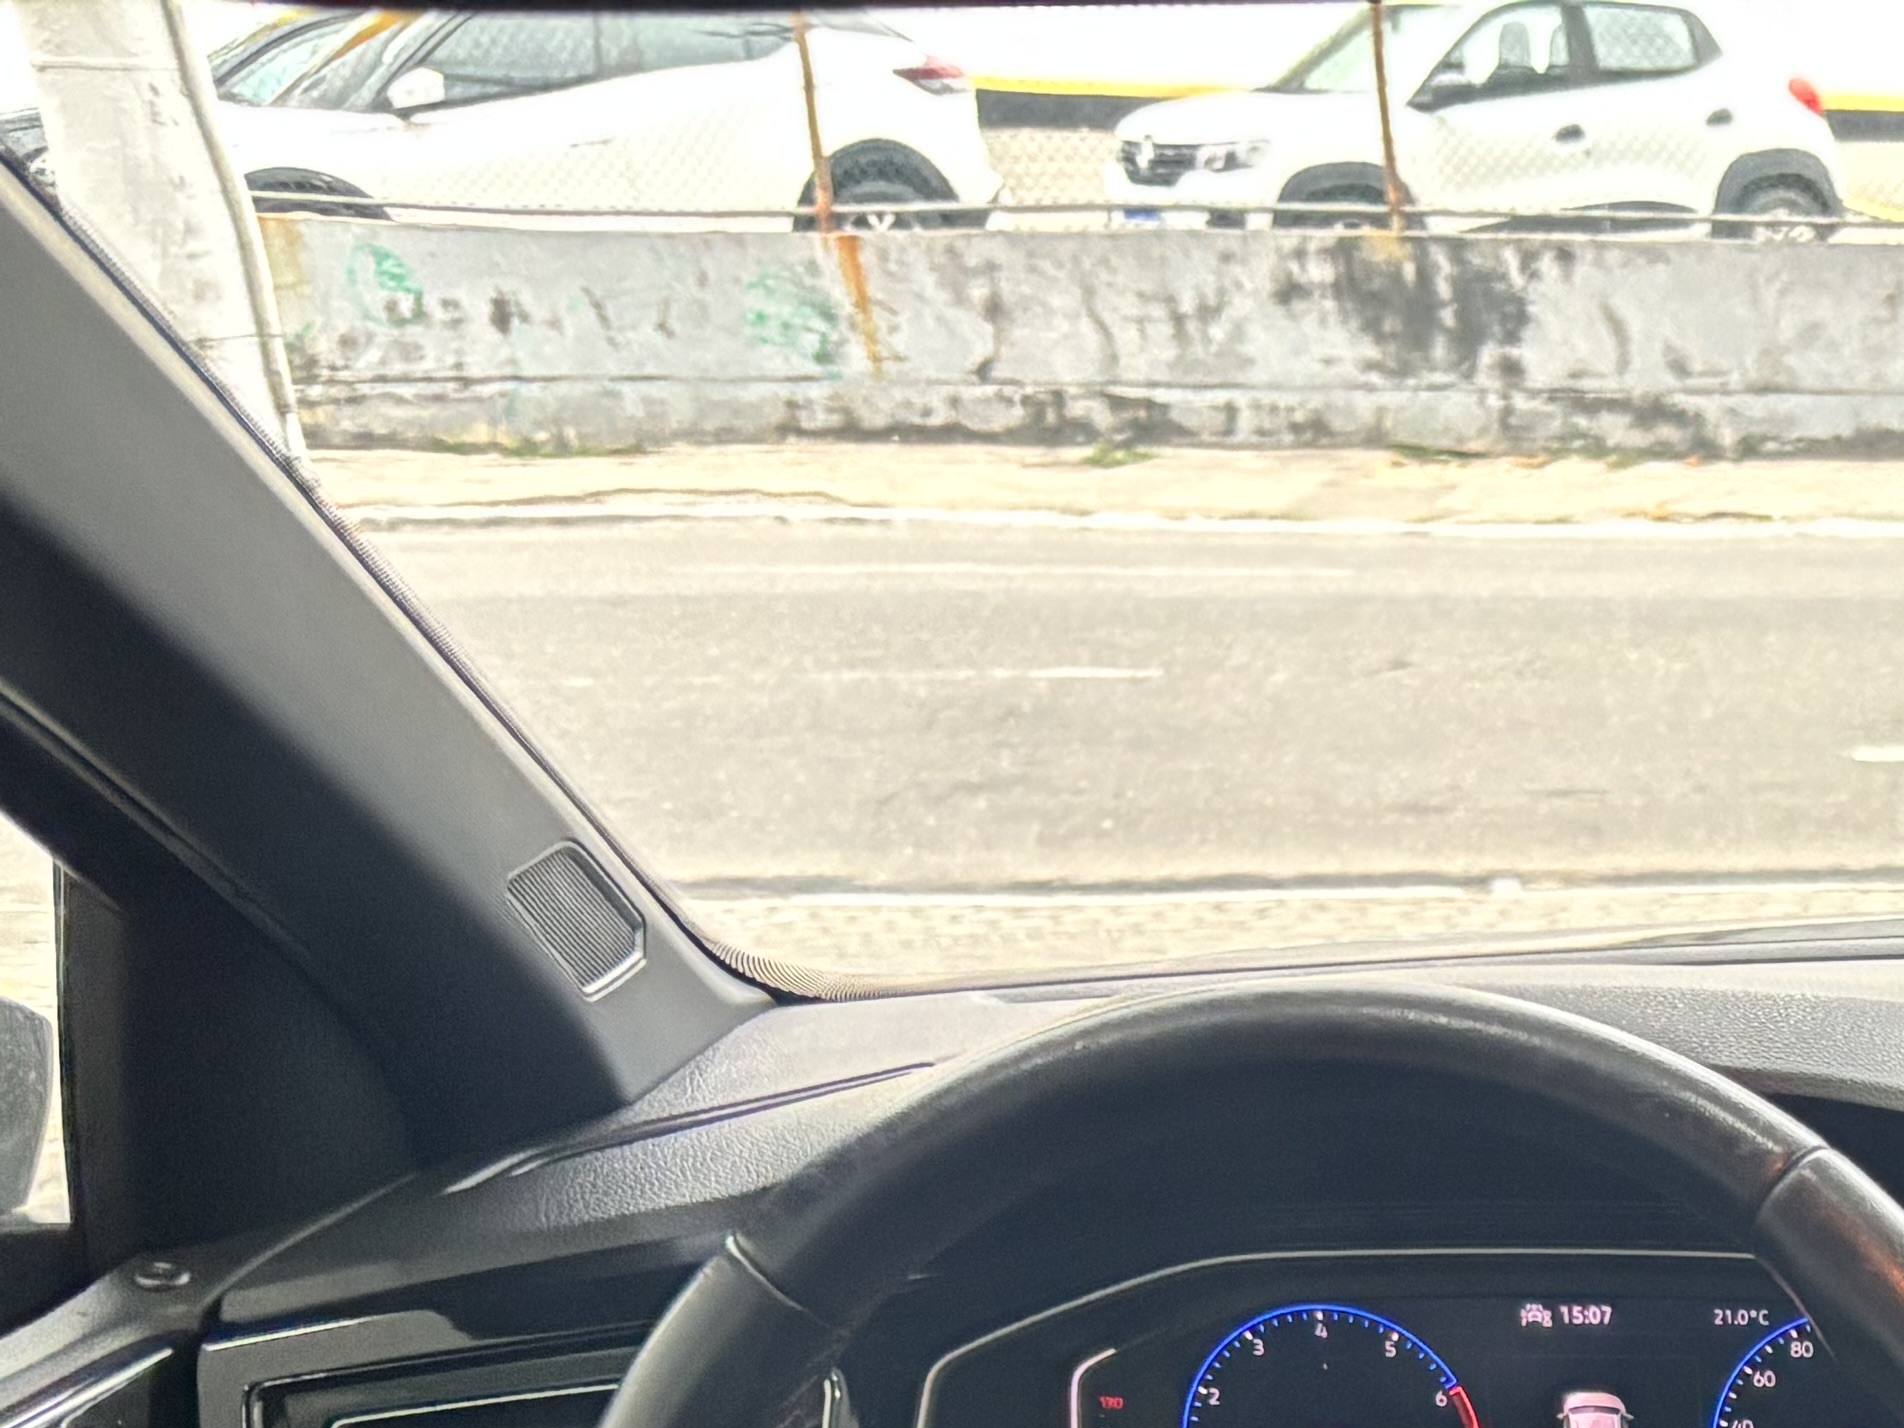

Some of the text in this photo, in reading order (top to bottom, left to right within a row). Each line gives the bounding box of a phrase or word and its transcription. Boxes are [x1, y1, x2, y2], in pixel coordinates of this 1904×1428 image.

[1560, 1305, 1612, 1325] 15:07
[1713, 1309, 1769, 1326] 21.0°C
[1315, 1323, 1328, 1338] 4
[1253, 1339, 1264, 1355] 3
[1385, 1341, 1397, 1357] 5
[1790, 1341, 1814, 1359] 80
[1753, 1370, 1776, 1388] 60
[1209, 1388, 1220, 1405] 2
[1435, 1391, 1448, 1407] 6
